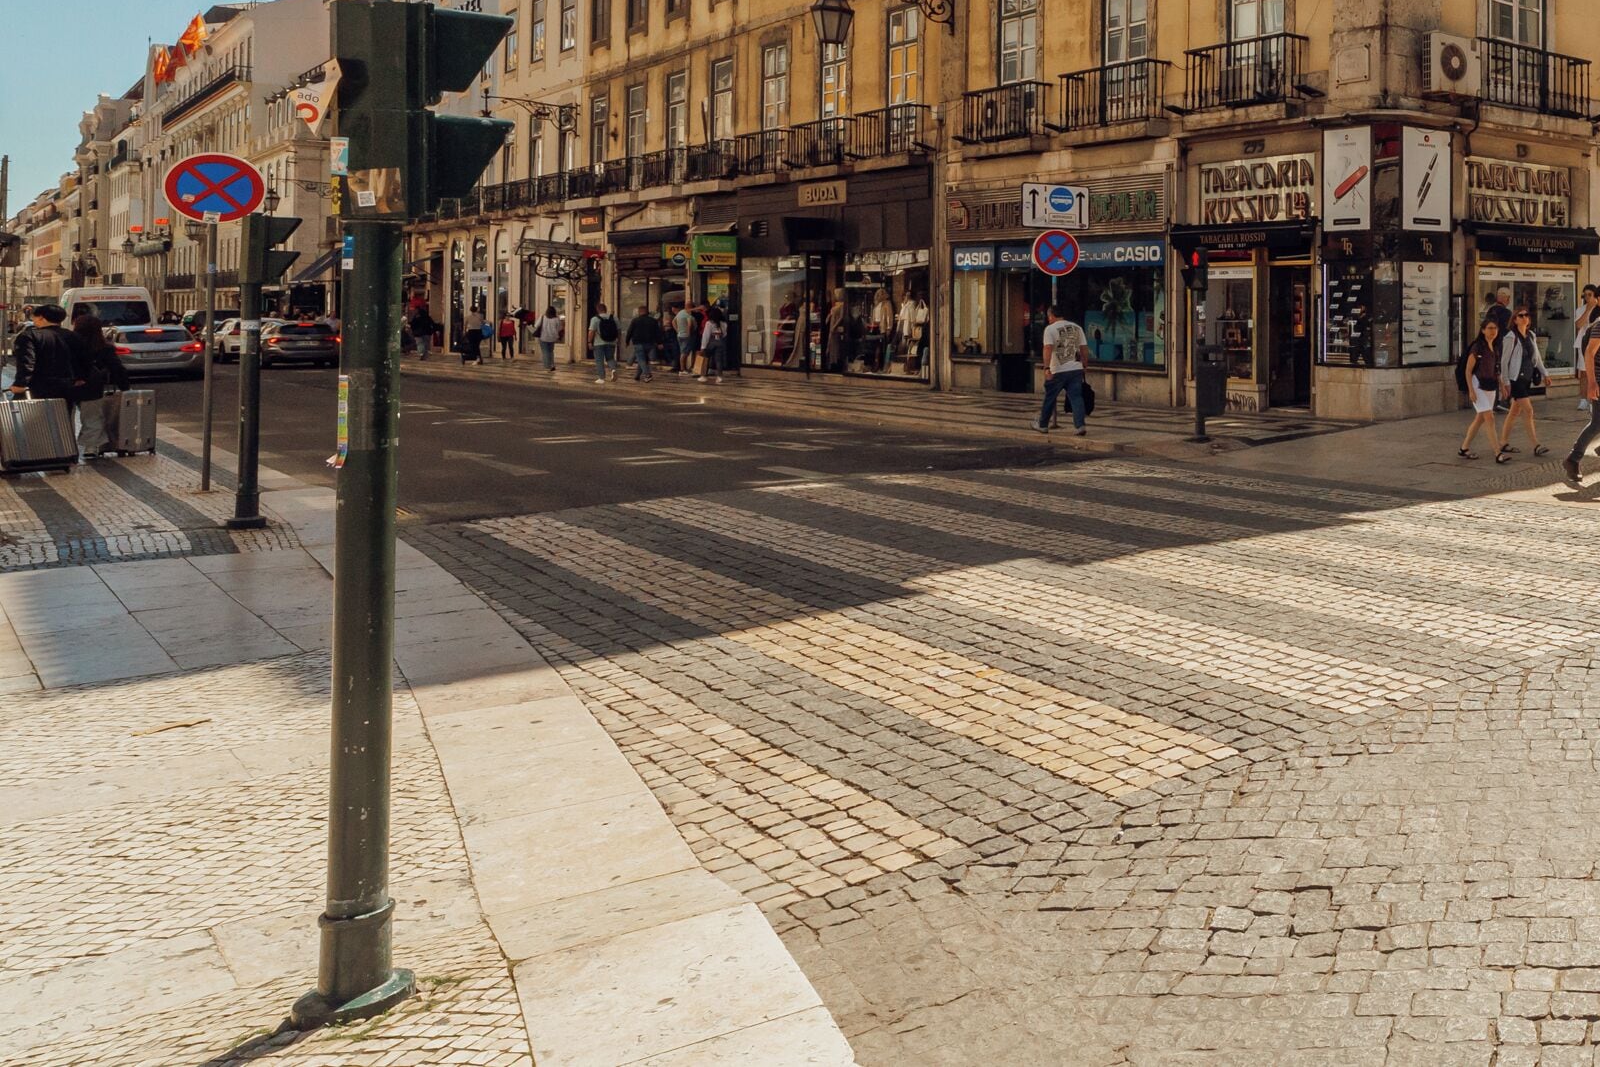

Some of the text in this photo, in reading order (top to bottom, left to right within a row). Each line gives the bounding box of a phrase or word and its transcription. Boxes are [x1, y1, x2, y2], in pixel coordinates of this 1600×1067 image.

[1200, 158, 1315, 194] TABACARIA
[1467, 162, 1571, 197] TABACARIA
[805, 186, 838, 202] BUDA
[972, 201, 1022, 230] FUJIF
[1205, 193, 1279, 225] ROSSIO
[1470, 195, 1539, 225] ROSSIO
[1201, 232, 1266, 244] TABACARIA ROSSIO
[1507, 236, 1575, 249] TABACARIA ROSSIO
[669, 245, 690, 253] ATM
[1114, 246, 1161, 262] CASIO
[956, 252, 990, 266] CASIO
